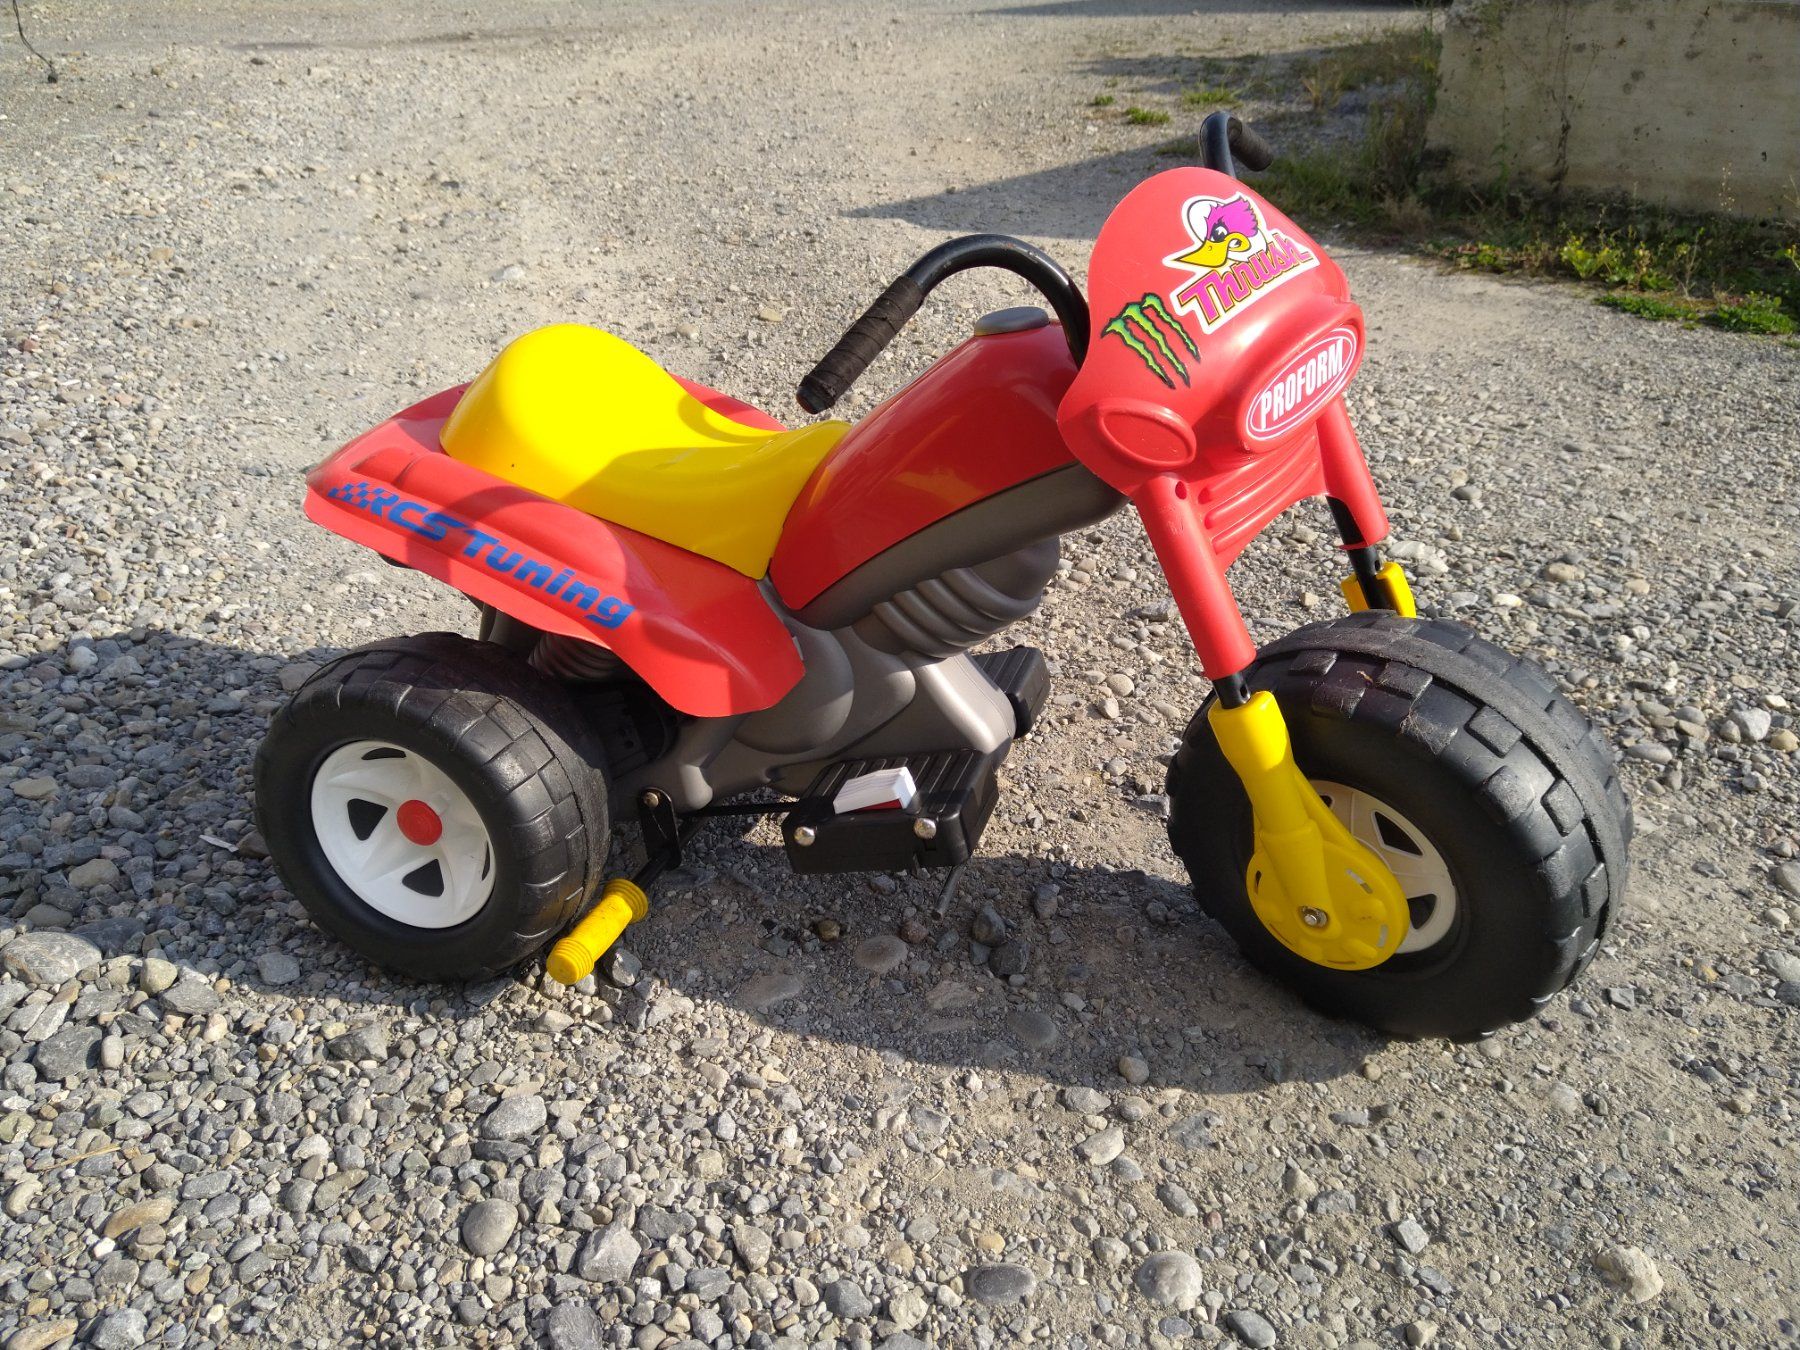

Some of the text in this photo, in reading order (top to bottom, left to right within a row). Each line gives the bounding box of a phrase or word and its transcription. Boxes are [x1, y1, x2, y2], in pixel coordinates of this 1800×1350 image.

[1176, 233, 1313, 324] Thrush
[1260, 337, 1344, 430] PROFORM
[366, 487, 636, 629] RCS Tuning
